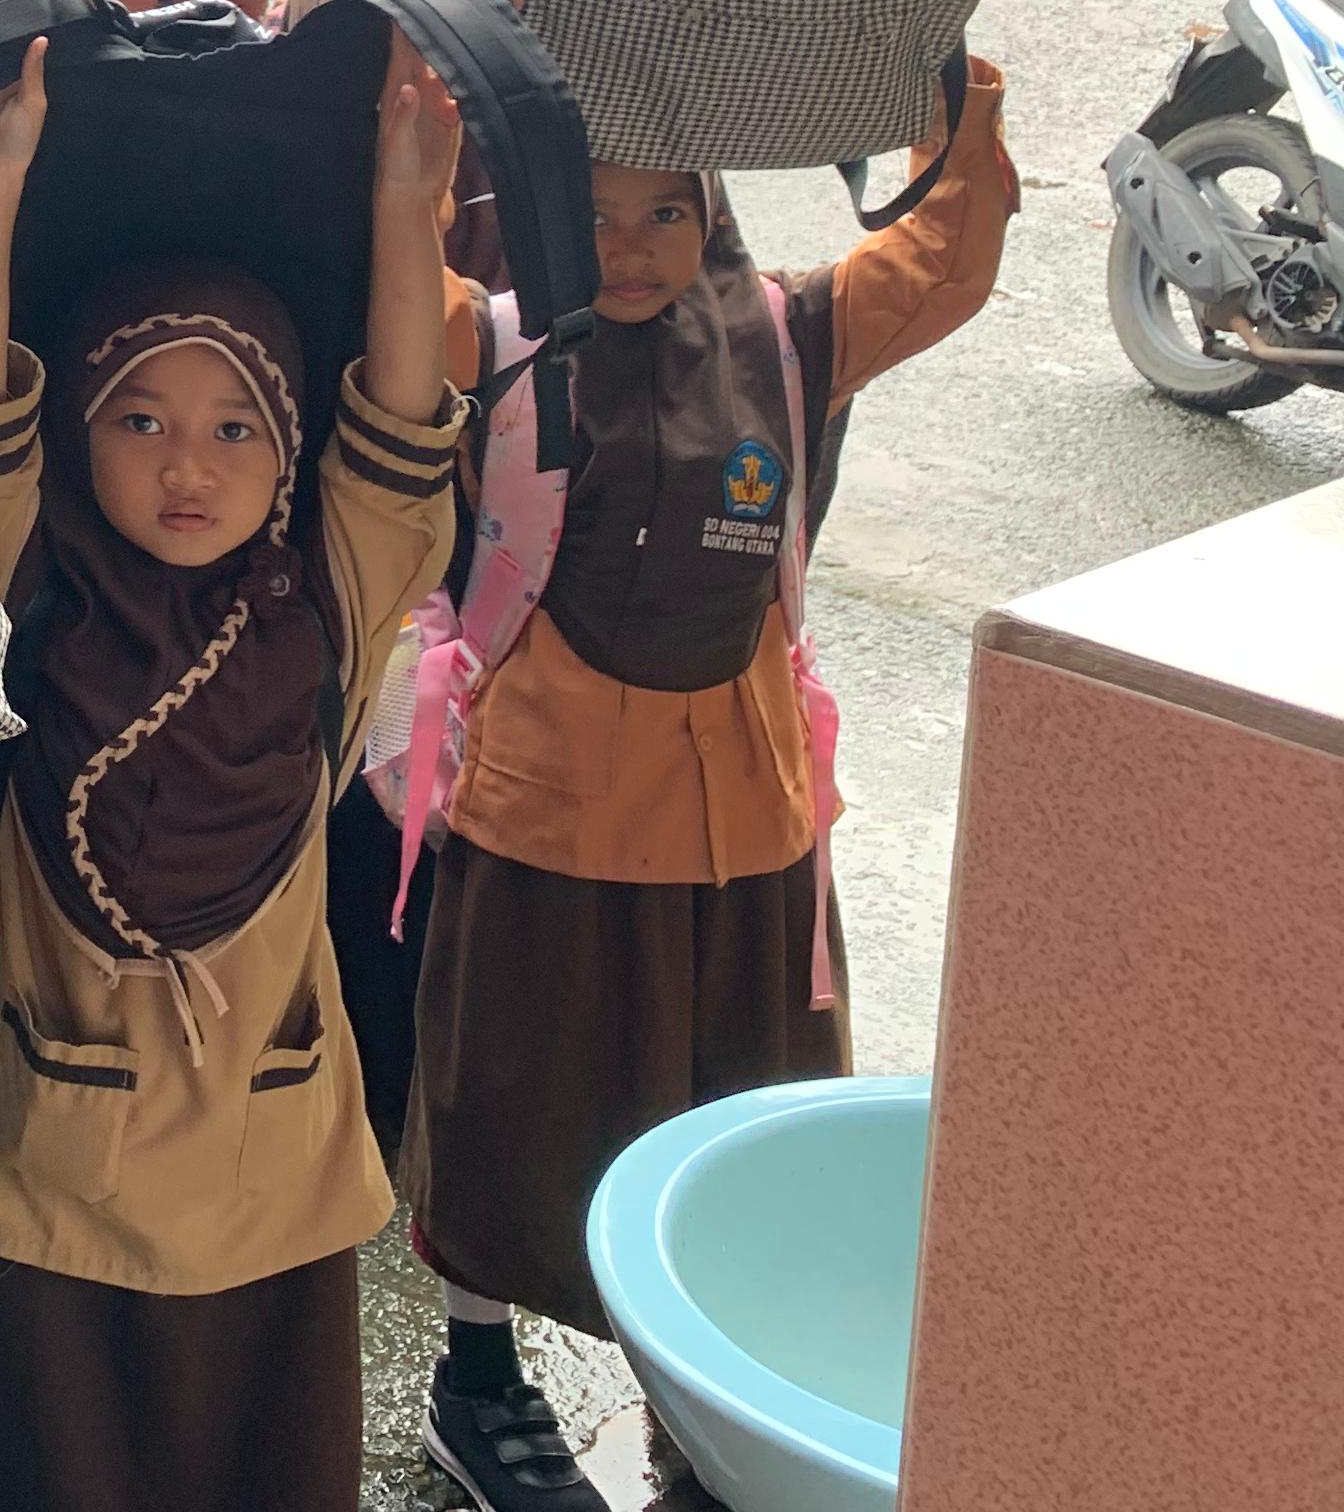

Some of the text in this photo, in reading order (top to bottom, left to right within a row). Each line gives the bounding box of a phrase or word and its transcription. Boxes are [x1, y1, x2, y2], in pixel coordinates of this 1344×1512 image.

[703, 517, 719, 532] SD
[720, 519, 760, 538] NEGERI
[701, 533, 775, 556] BONTANG UTARA
